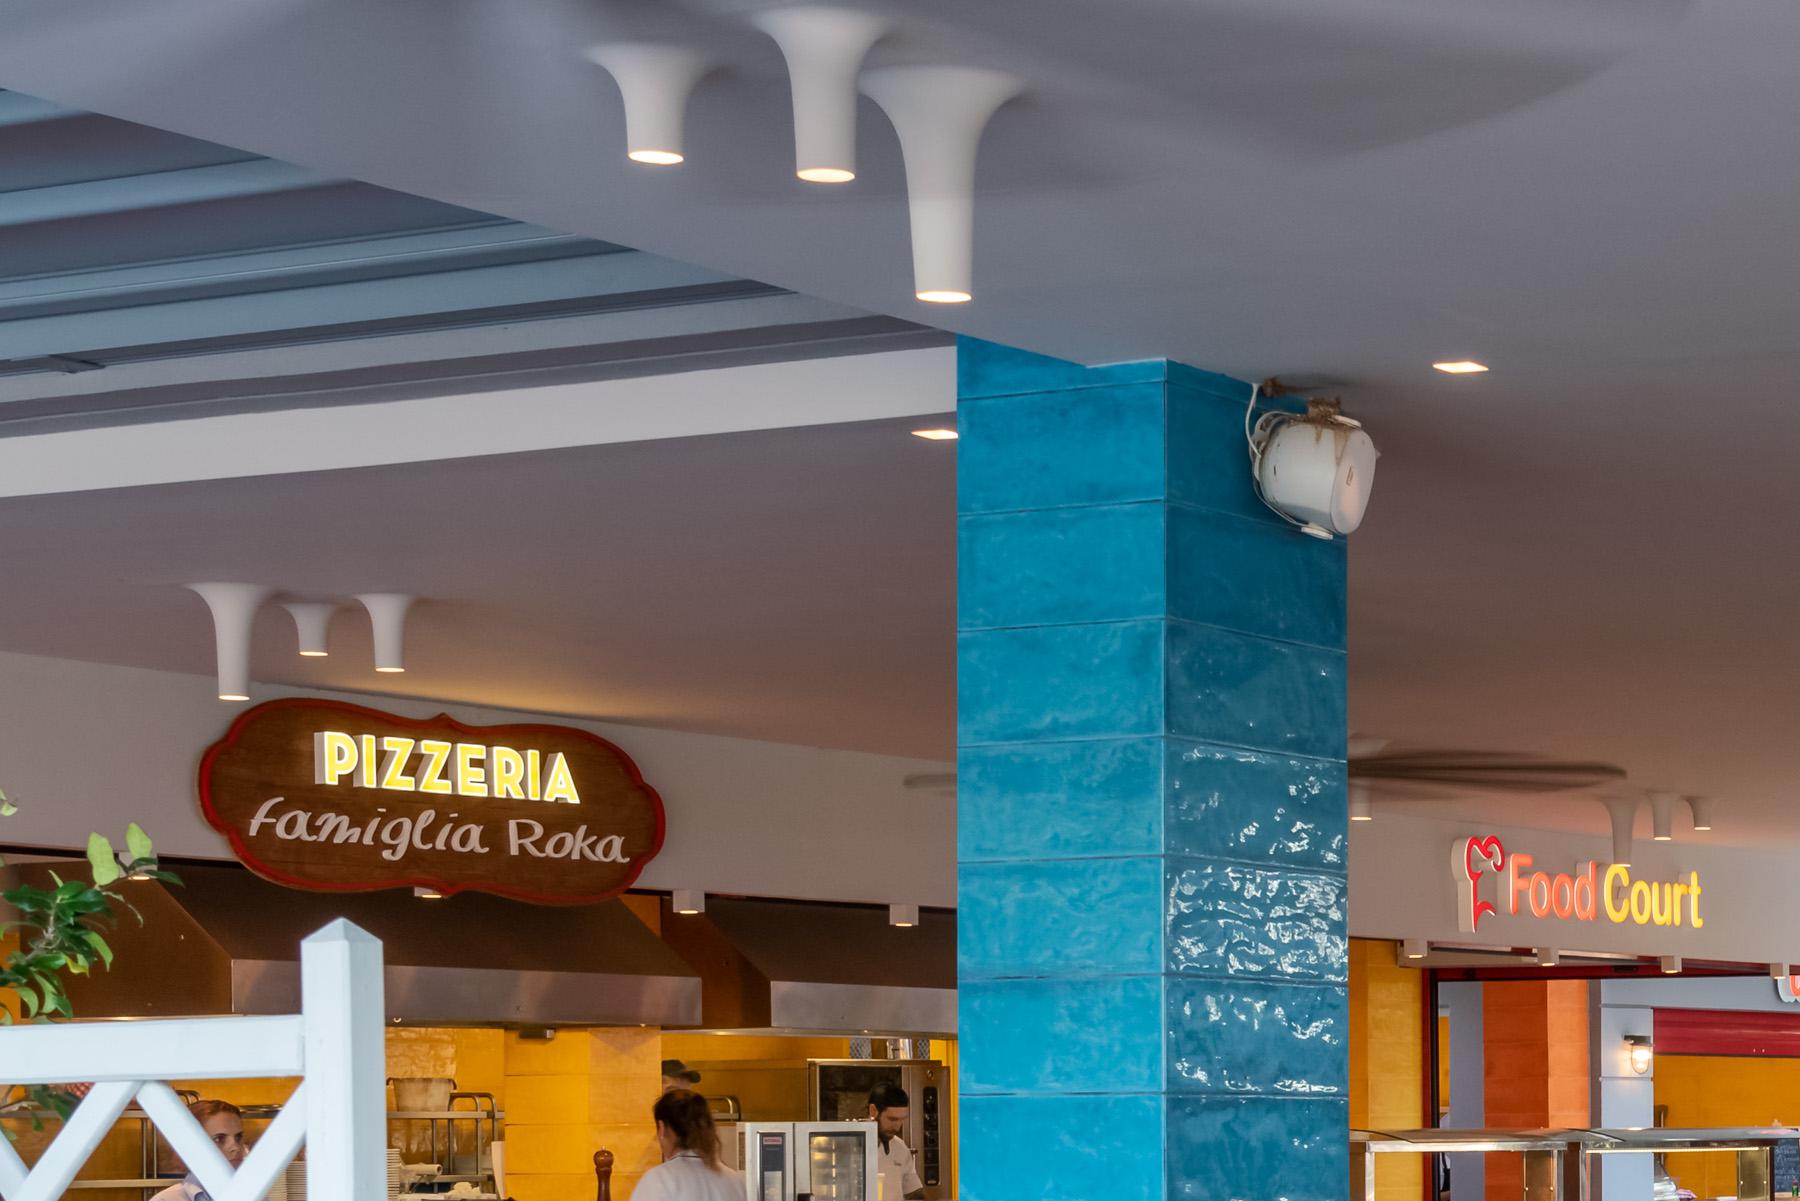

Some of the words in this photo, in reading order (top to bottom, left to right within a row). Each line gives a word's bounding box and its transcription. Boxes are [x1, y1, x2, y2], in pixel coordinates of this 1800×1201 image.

[319, 731, 581, 805] PIZZERIA
[507, 818, 631, 864] Roka
[1508, 853, 1598, 921] Food
[1603, 863, 1704, 928] Court
